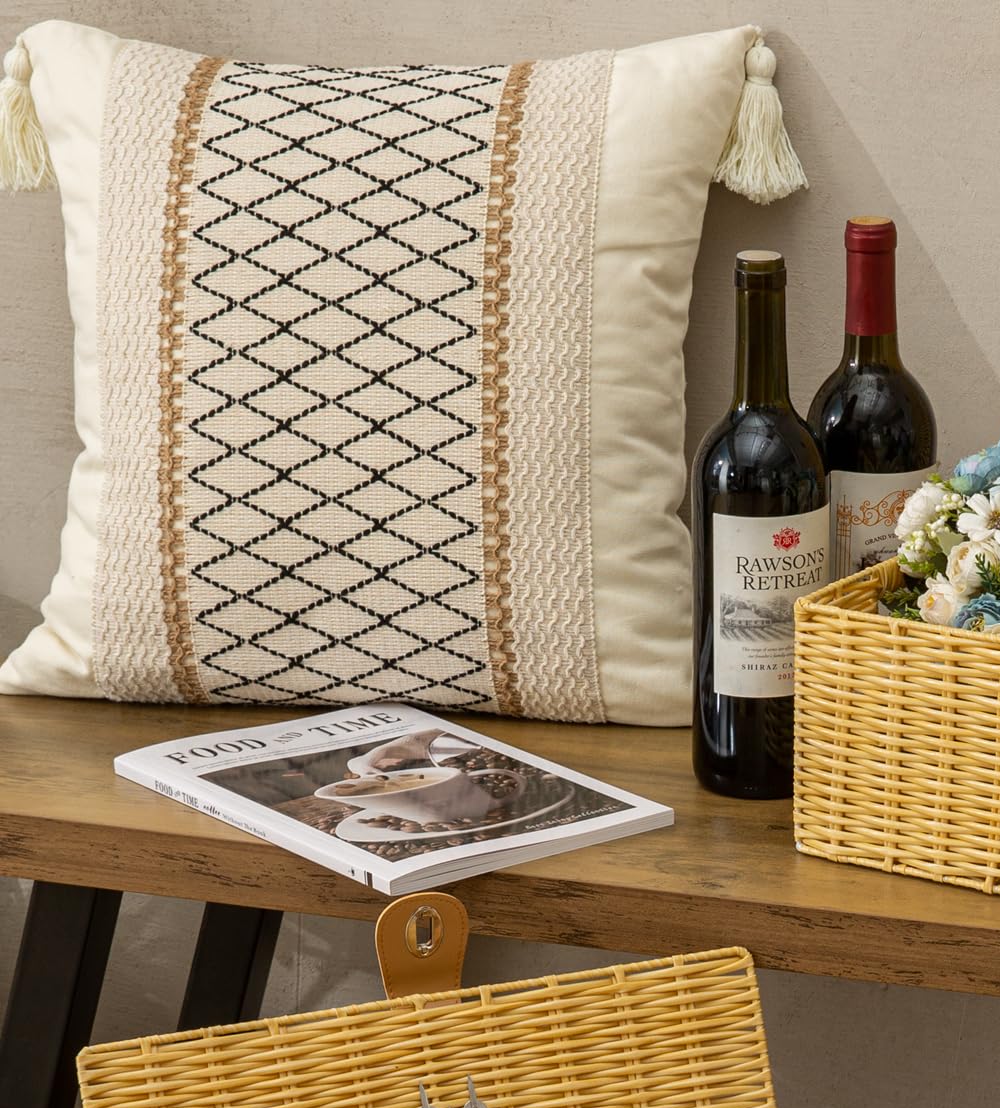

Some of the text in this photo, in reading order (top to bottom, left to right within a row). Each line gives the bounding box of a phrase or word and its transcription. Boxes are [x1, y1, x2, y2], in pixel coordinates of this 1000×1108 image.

[864, 534, 887, 545] GRAND
[736, 547, 825, 576] RAWSON'S
[743, 567, 822, 591] RETREAT
[741, 663, 778, 671] SHIRAZ
[163, 738, 267, 764] FOOD
[273, 731, 303, 745] AND
[308, 712, 402, 737] TIME
[154, 780, 173, 797] FOOD
[181, 792, 199, 808] TIME
